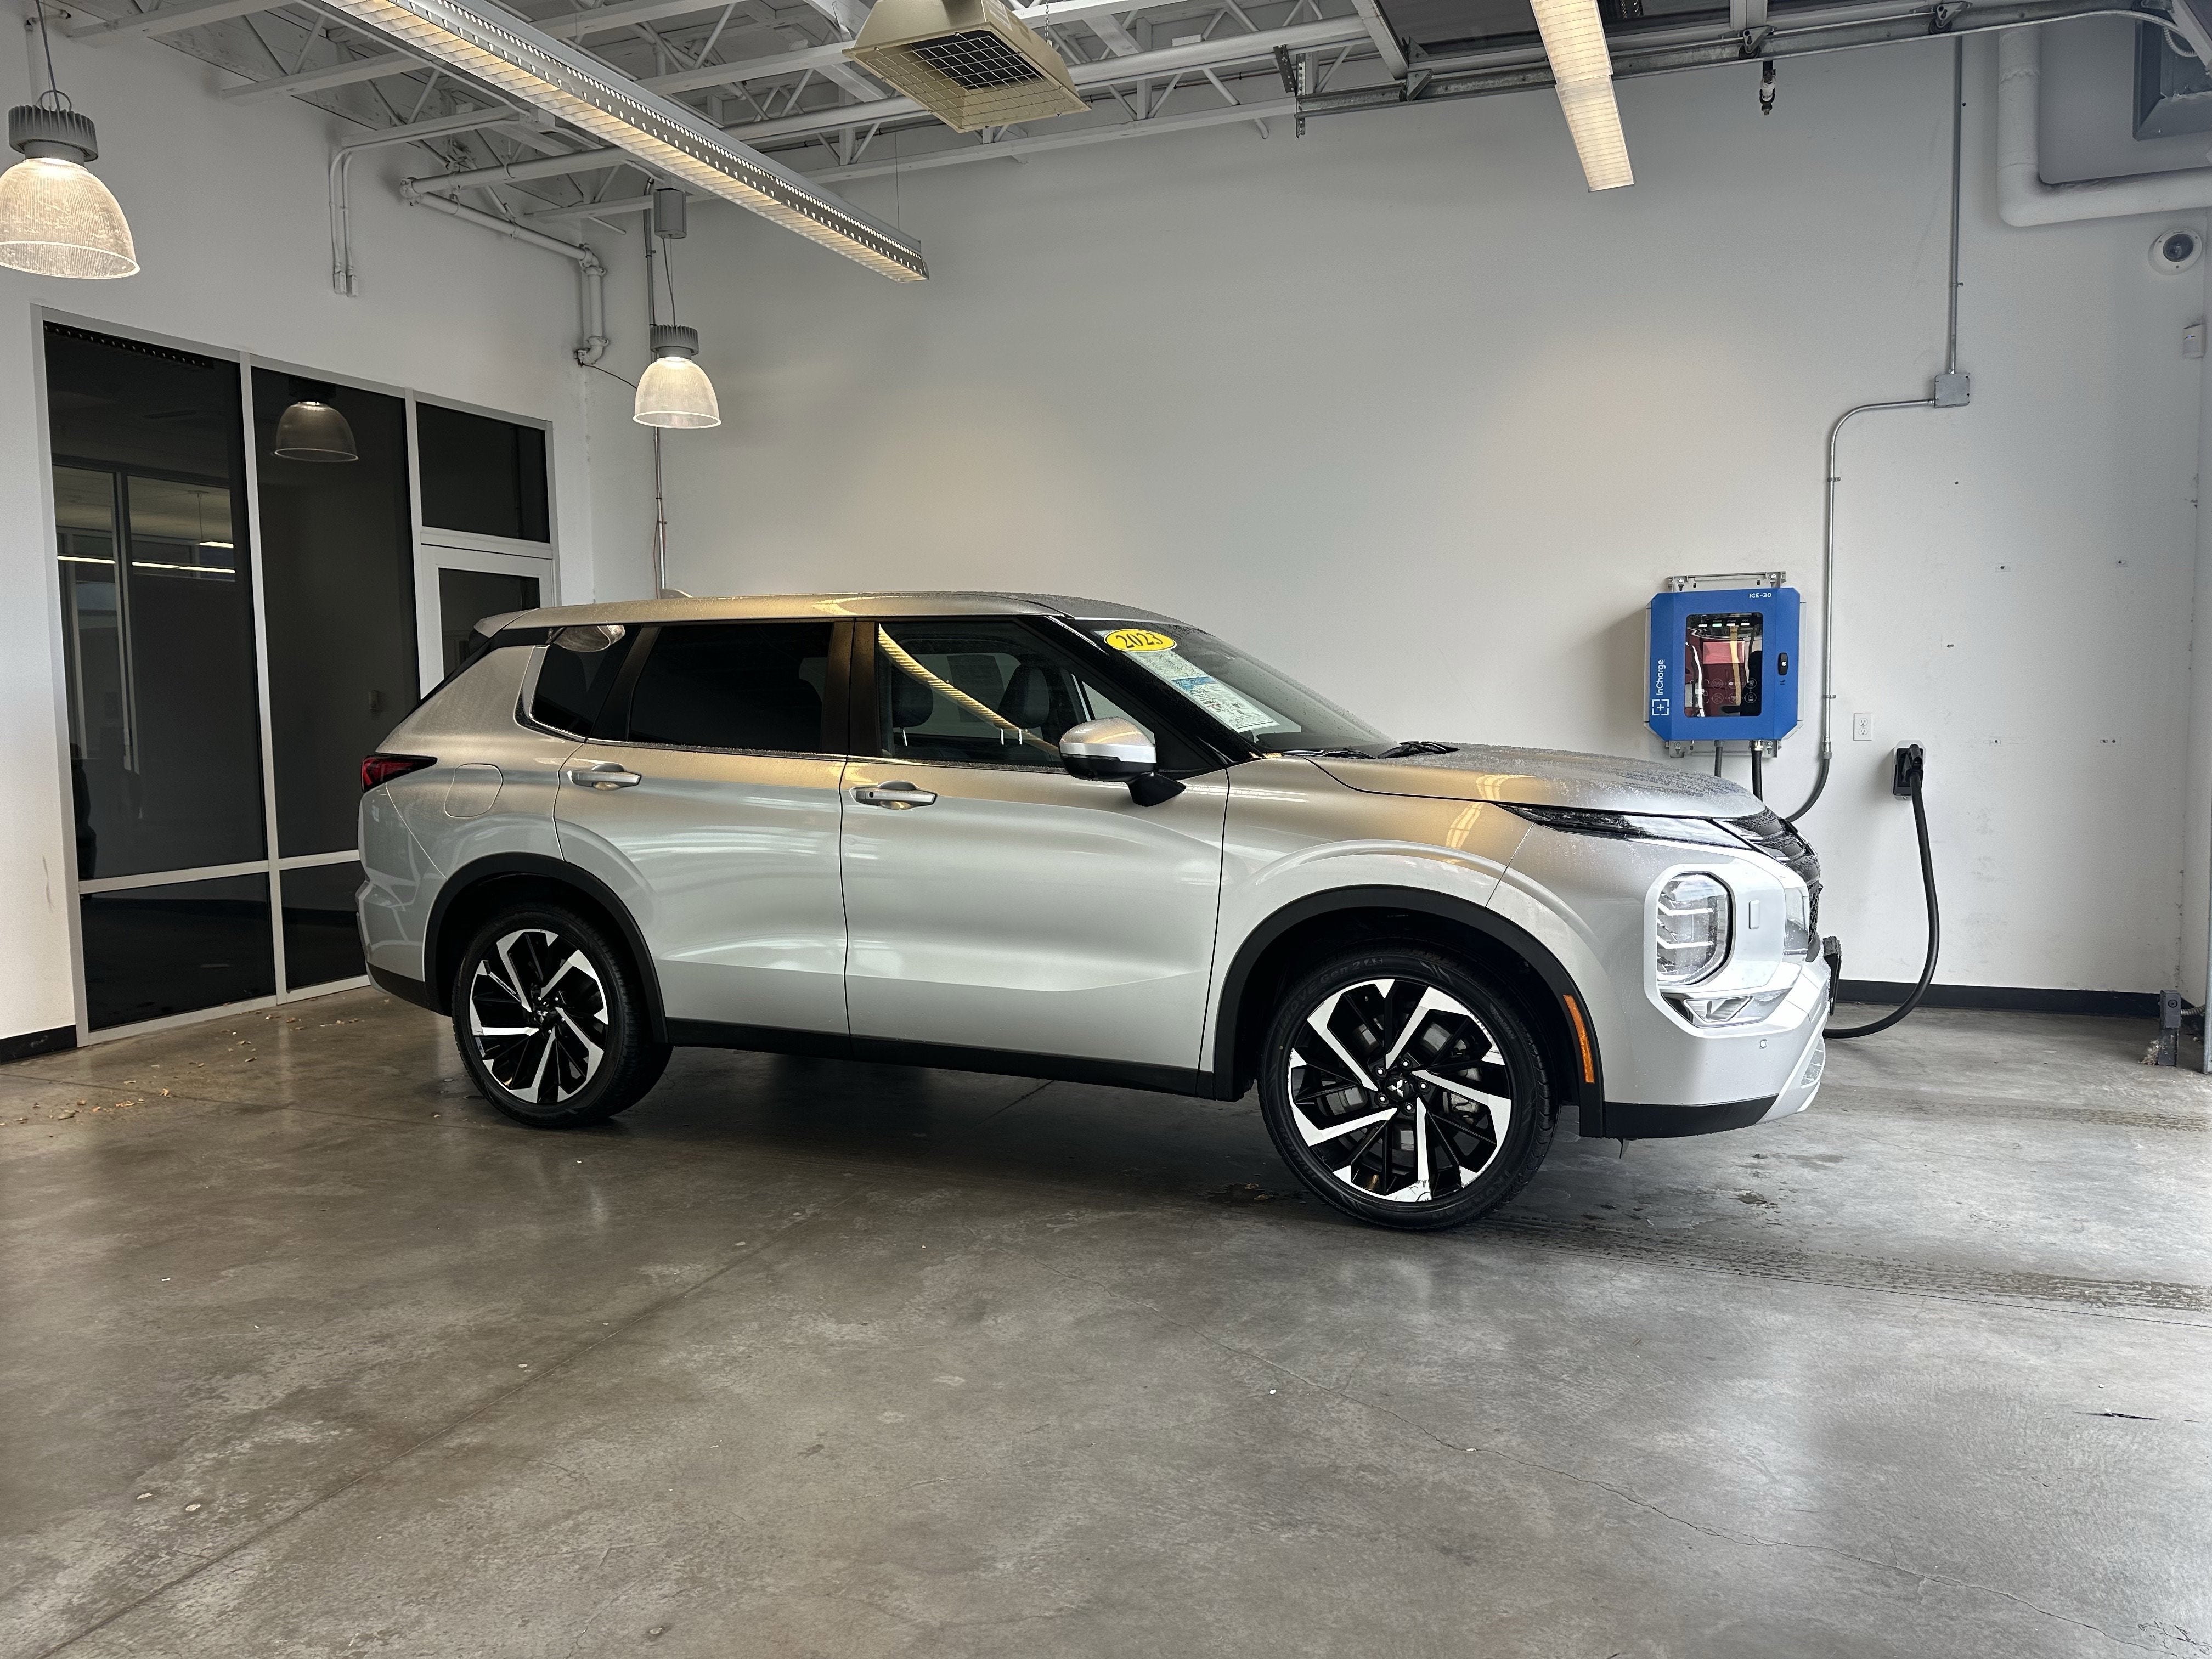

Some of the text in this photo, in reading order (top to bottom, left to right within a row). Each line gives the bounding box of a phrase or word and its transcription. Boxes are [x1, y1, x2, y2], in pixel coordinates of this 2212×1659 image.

[1115, 632, 1163, 648] 2023
[1656, 659, 1666, 696] InCharge
[1352, 961, 1361, 969] 2
